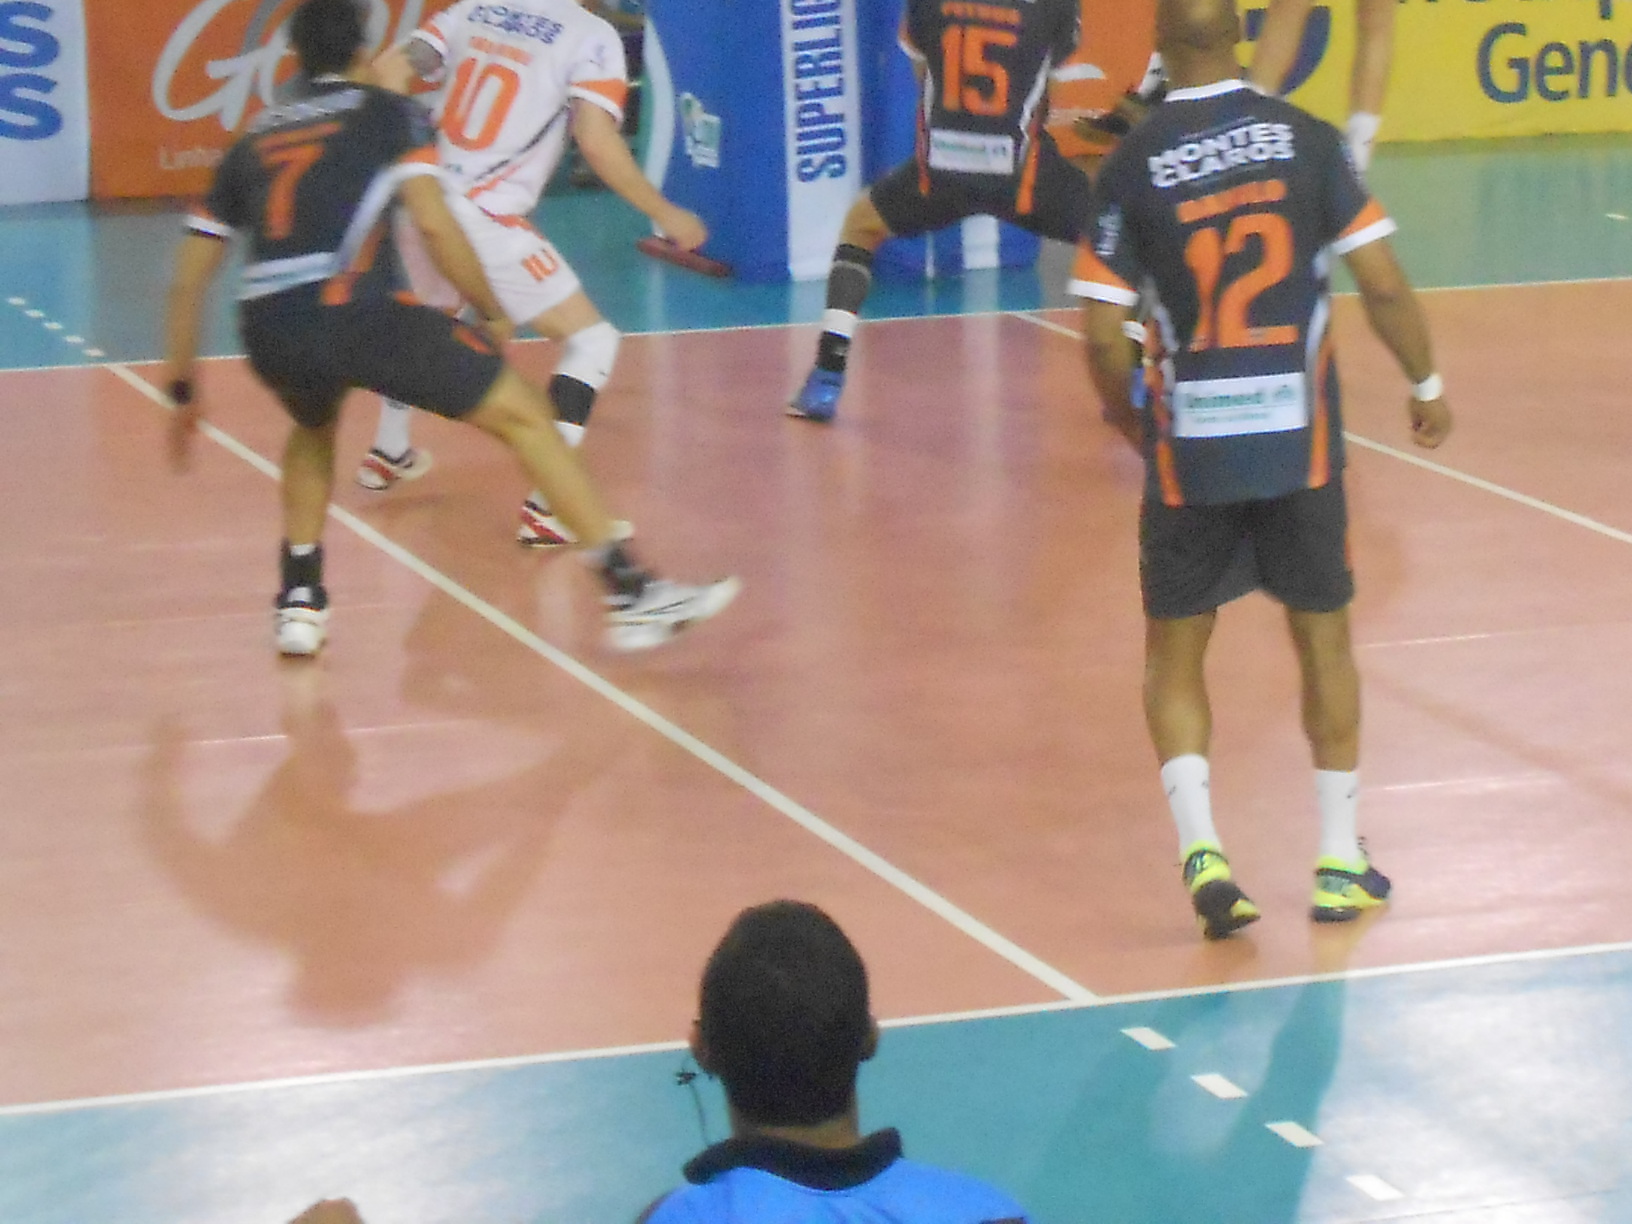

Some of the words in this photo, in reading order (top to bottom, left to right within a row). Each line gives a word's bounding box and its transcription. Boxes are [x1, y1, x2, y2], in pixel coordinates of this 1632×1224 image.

[440, 57, 521, 152] 10
[941, 24, 1018, 117] 15
[260, 142, 326, 241] 7
[1184, 211, 1299, 352] 12
